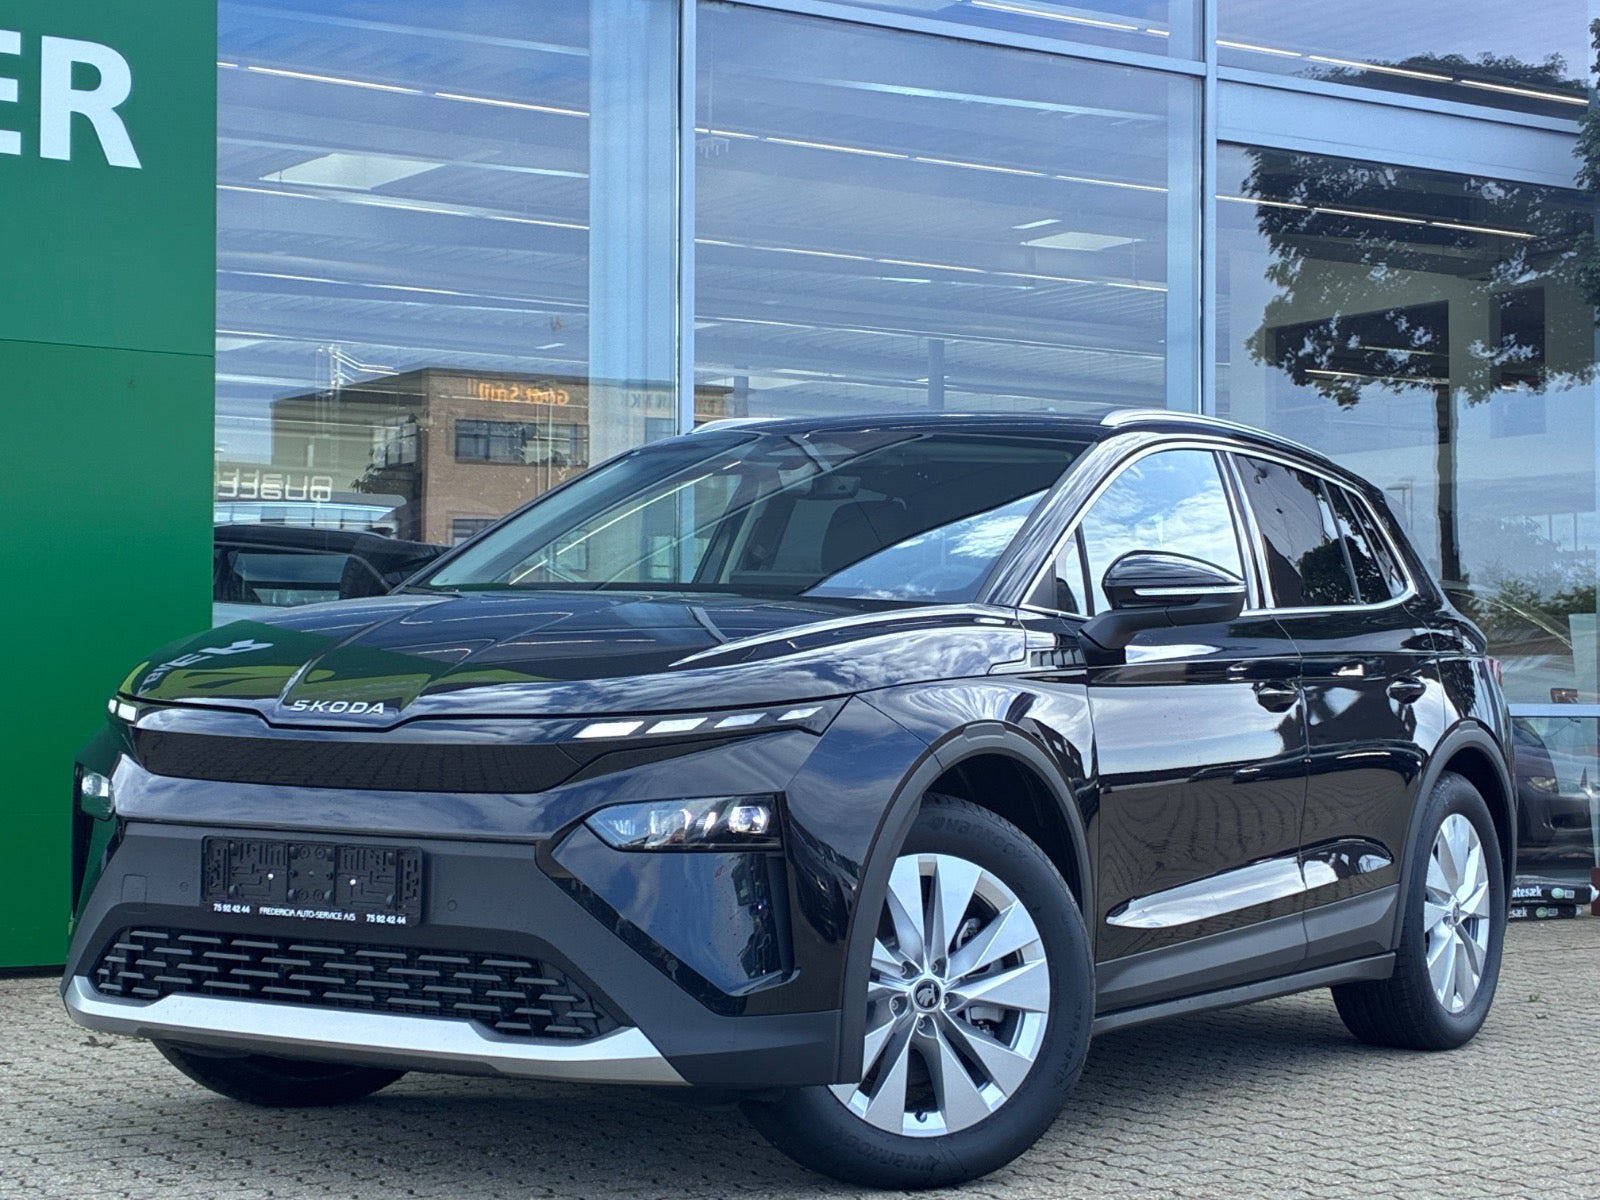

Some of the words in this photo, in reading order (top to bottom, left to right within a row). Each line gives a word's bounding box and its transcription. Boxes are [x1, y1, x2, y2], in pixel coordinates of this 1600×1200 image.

[213, 903, 222, 912] 75
[222, 904, 232, 913] 92
[232, 904, 241, 914] 42
[240, 905, 250, 914] 44
[259, 906, 296, 917] FREDERICIA
[366, 913, 376, 923] 75
[376, 914, 386, 924] 92
[386, 915, 396, 925] 42
[396, 916, 407, 925] 44
